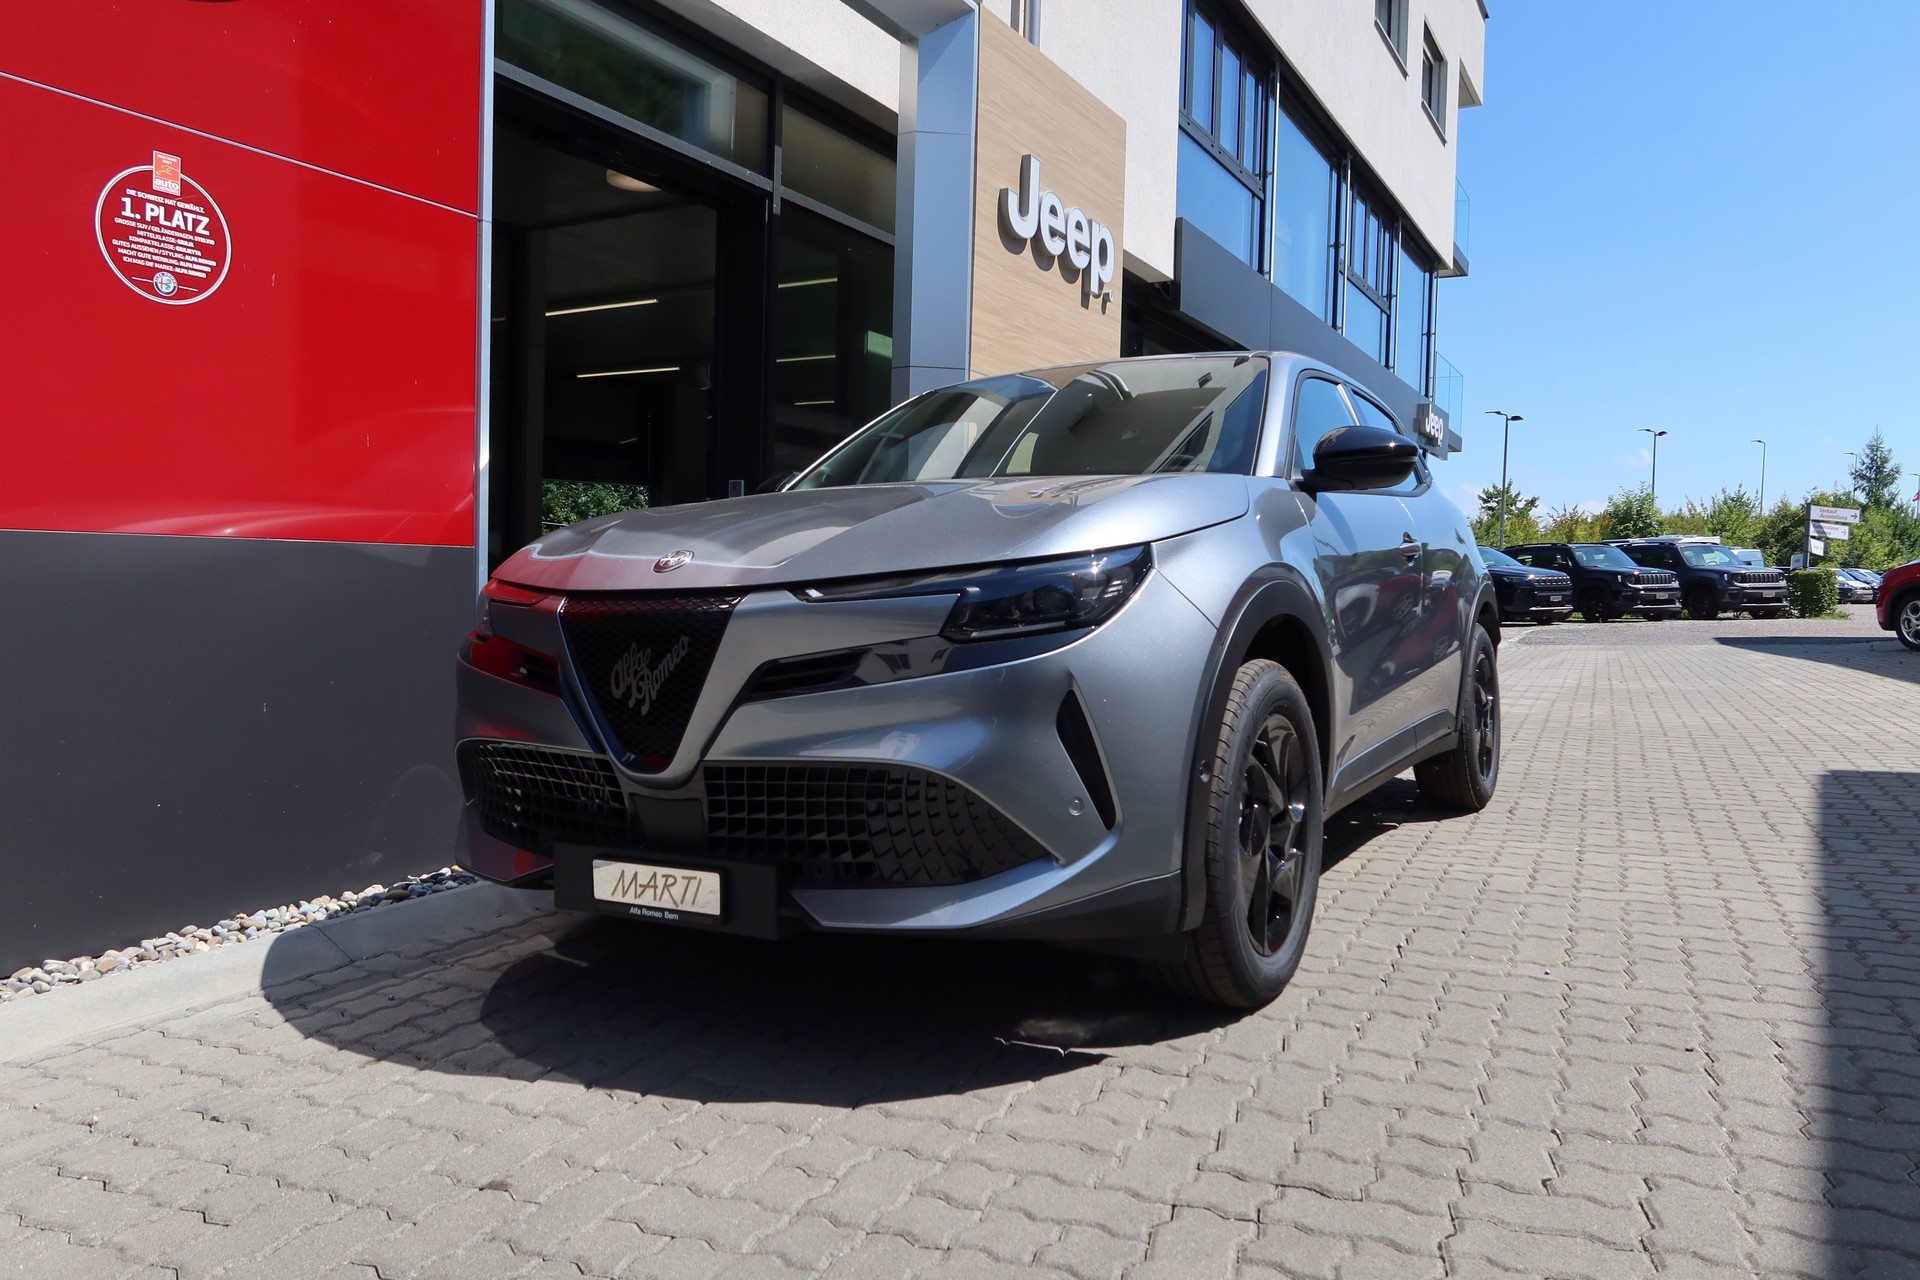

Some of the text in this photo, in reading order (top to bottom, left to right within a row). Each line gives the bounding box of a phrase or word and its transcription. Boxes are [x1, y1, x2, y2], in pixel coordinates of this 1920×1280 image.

[122, 197, 210, 235] 1. PLATZ
[1006, 154, 1115, 296] Jeep
[1426, 403, 1444, 446] Jeep
[611, 869, 702, 908] MARTI
[630, 907, 679, 920] Alfa Romeo Bern
